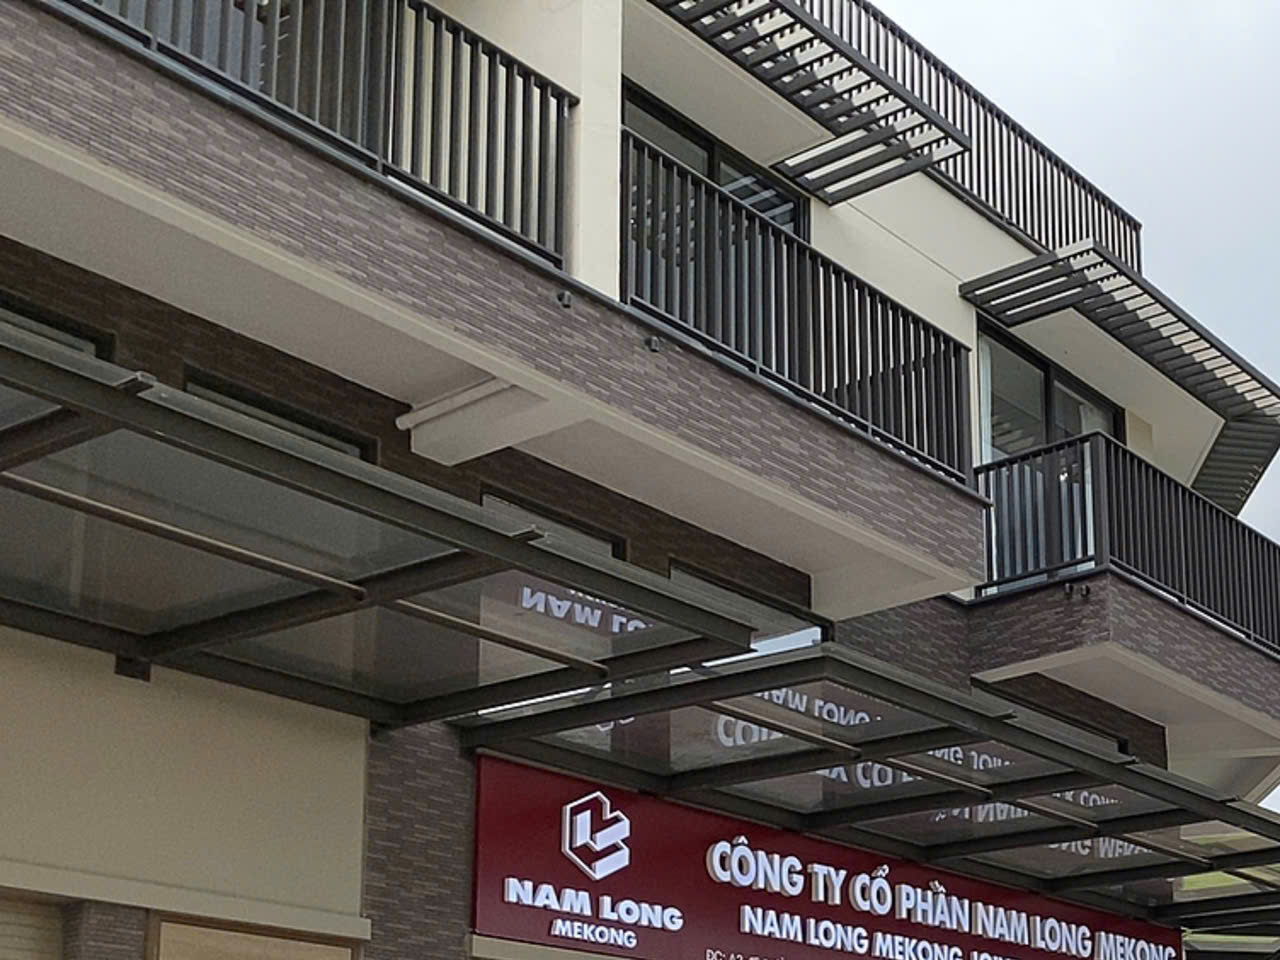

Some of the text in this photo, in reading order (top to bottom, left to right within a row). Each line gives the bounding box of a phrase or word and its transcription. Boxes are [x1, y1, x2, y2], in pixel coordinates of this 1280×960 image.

[504, 877, 684, 932] NAM LONG
[706, 835, 805, 897] CÔNG
[807, 862, 847, 906] TY
[850, 864, 893, 916] CỔ
[895, 879, 971, 934] PHẦN
[972, 900, 1029, 948] NAM
[1030, 915, 1092, 959] LONG
[551, 918, 638, 949] MEKONG
[740, 905, 803, 944] NAM
[807, 917, 869, 953] LONG
